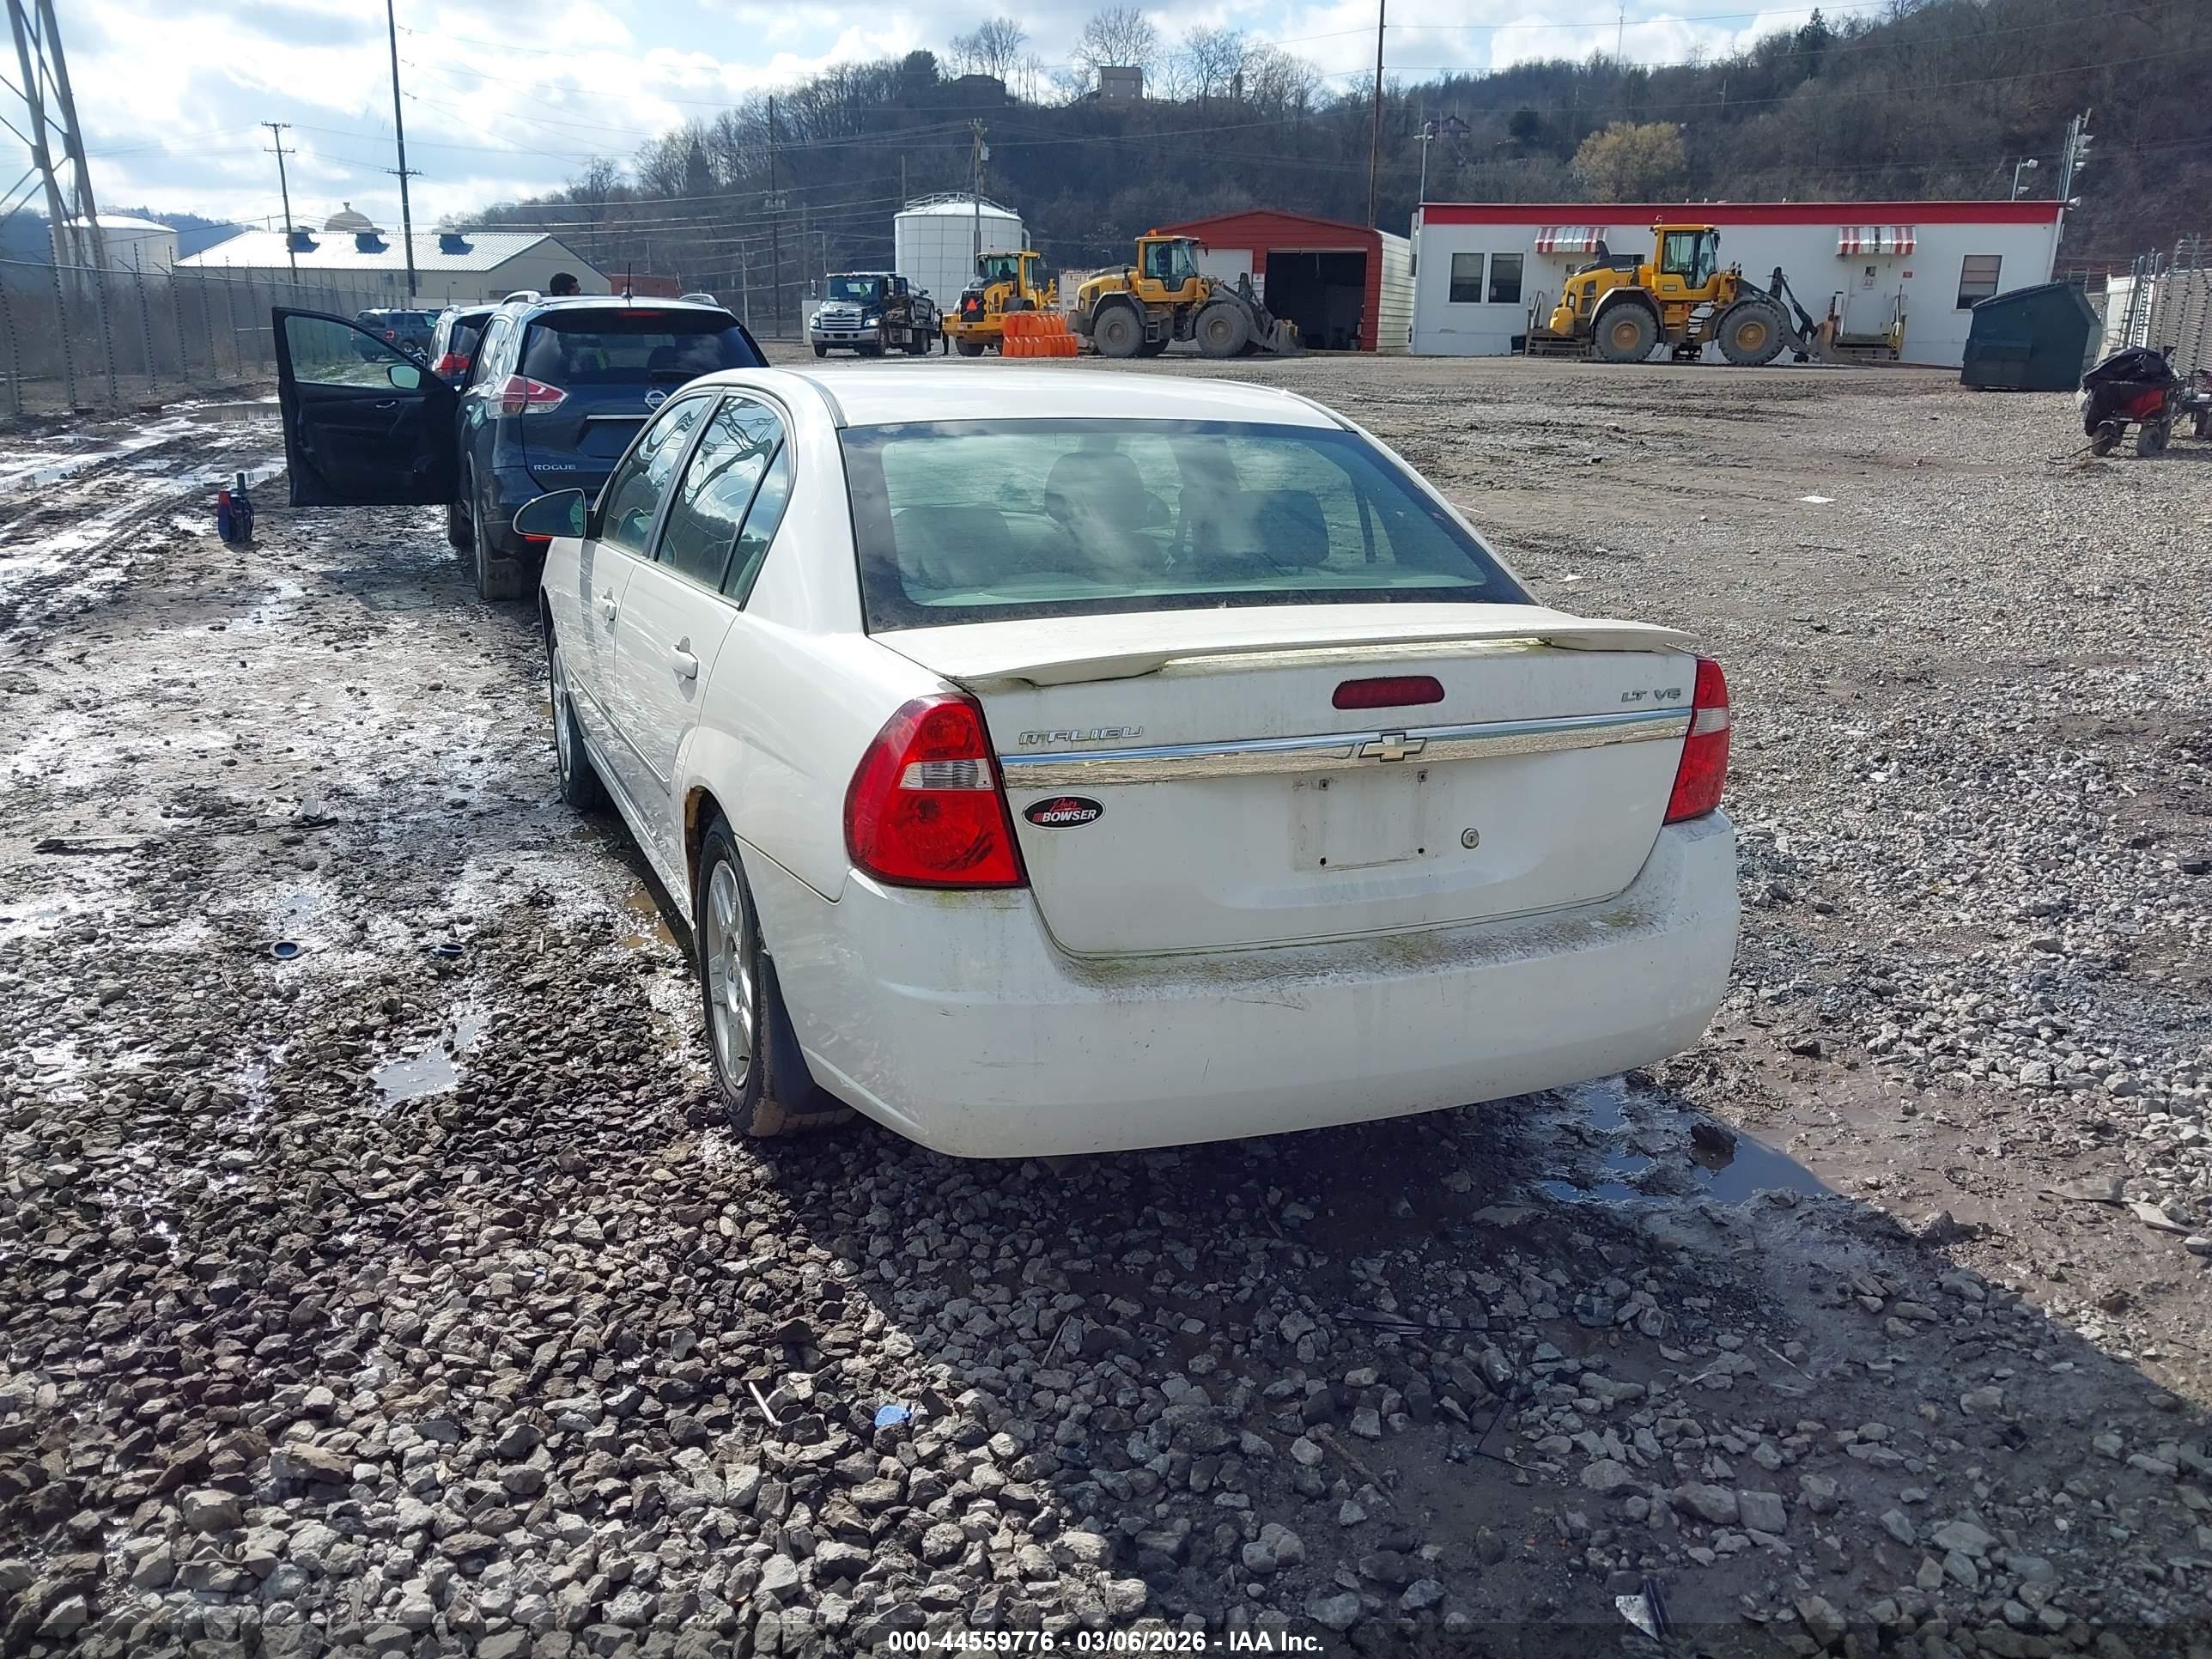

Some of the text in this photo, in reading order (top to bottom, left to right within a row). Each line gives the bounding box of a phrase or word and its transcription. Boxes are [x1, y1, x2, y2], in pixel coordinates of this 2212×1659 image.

[1621, 688, 1682, 702] LT V6
[1019, 726, 1143, 744] MALIBU
[1042, 810, 1097, 823] BOWSER
